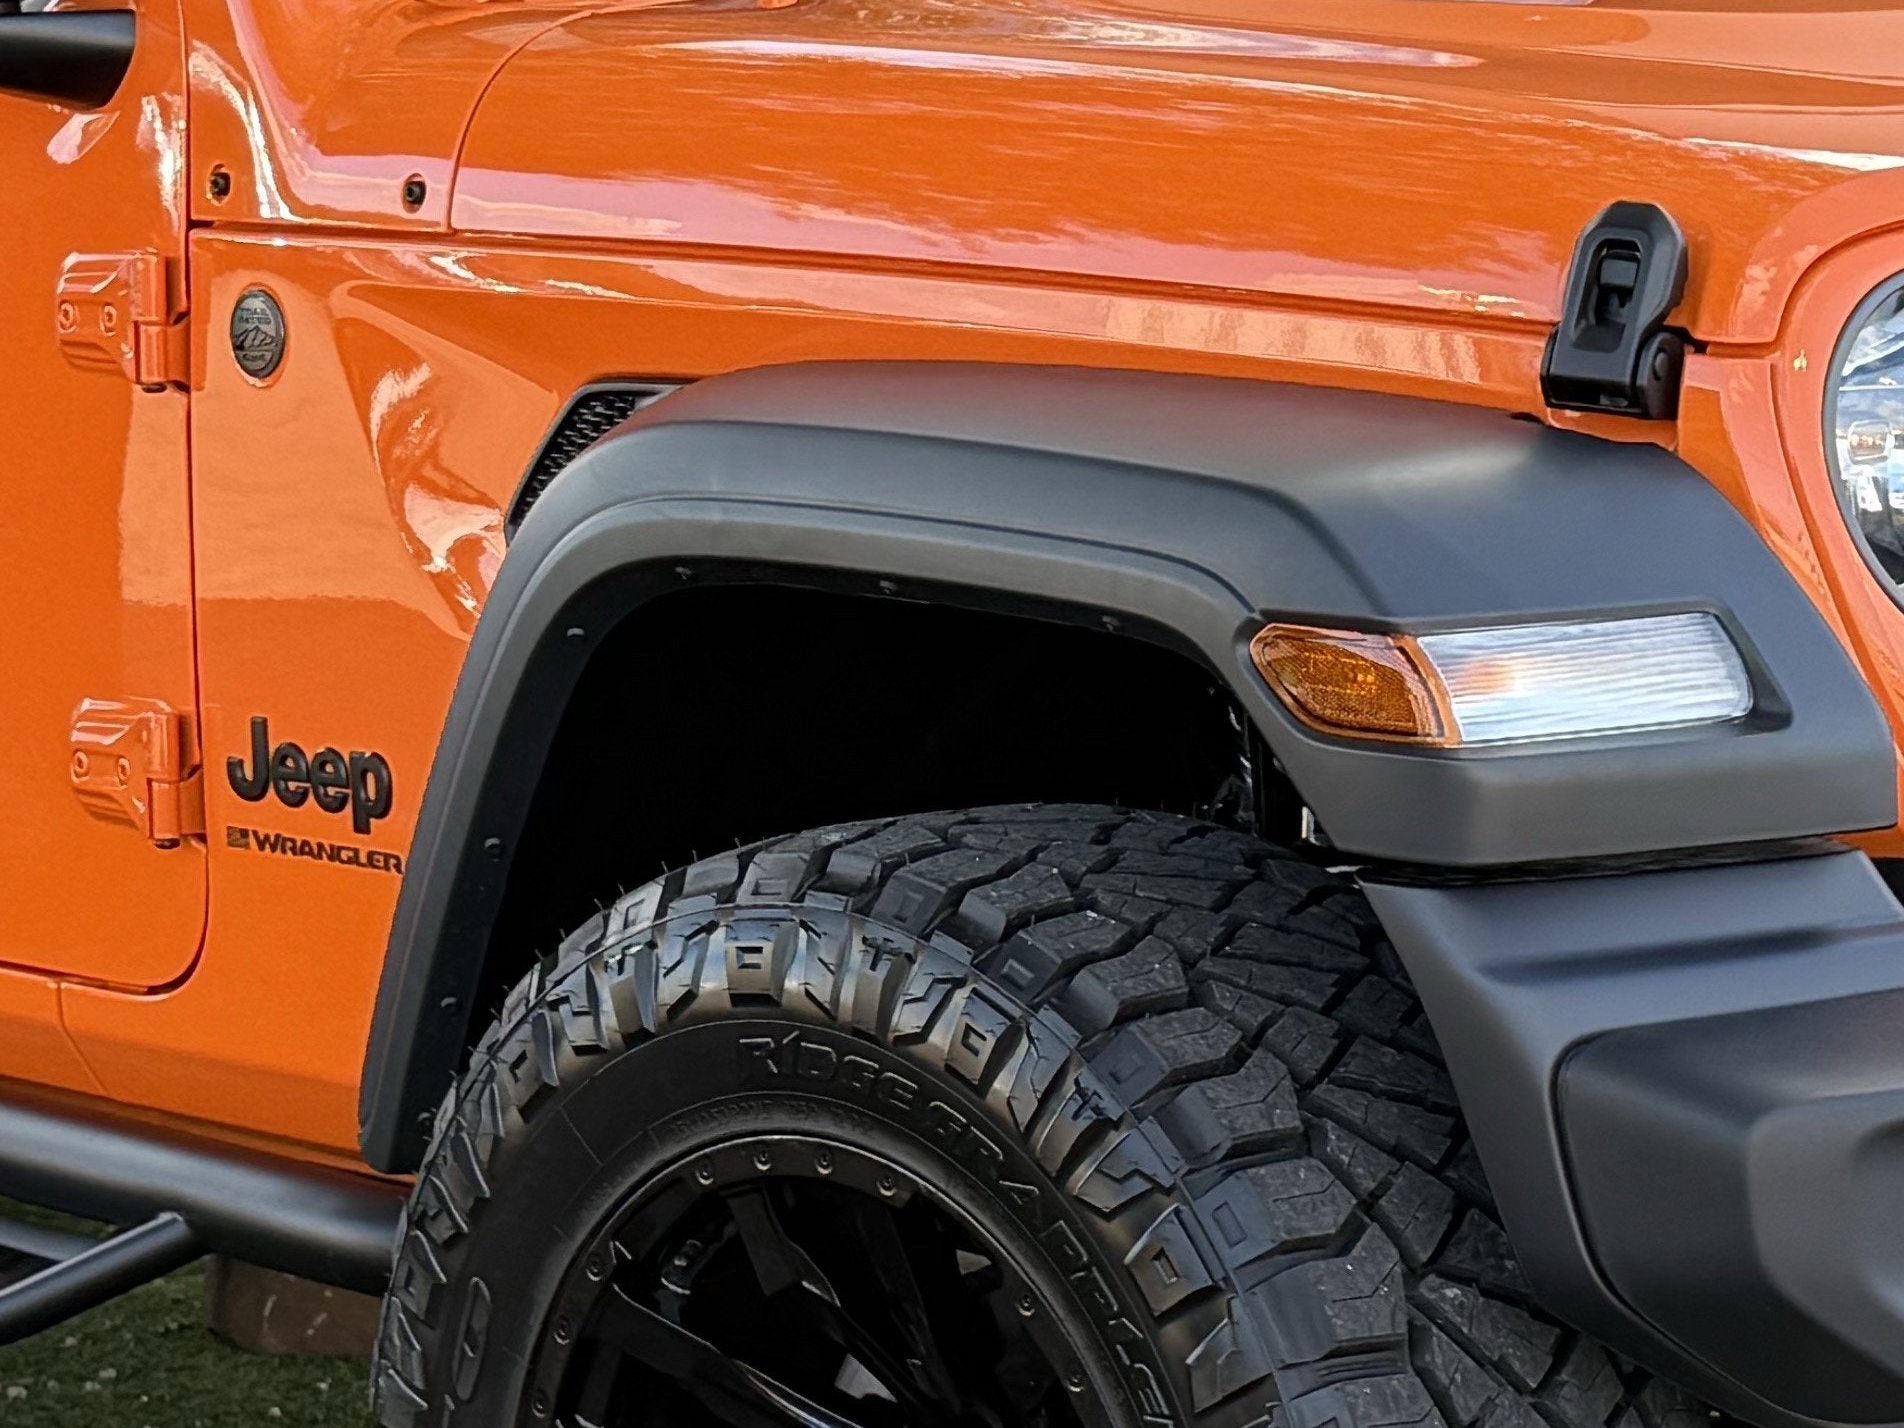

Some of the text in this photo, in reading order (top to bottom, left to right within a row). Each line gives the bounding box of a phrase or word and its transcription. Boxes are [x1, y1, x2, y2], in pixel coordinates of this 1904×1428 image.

[226, 715, 393, 835] Jeep
[251, 829, 404, 876] WRANGLER
[736, 1029, 920, 1113] RIDGE
